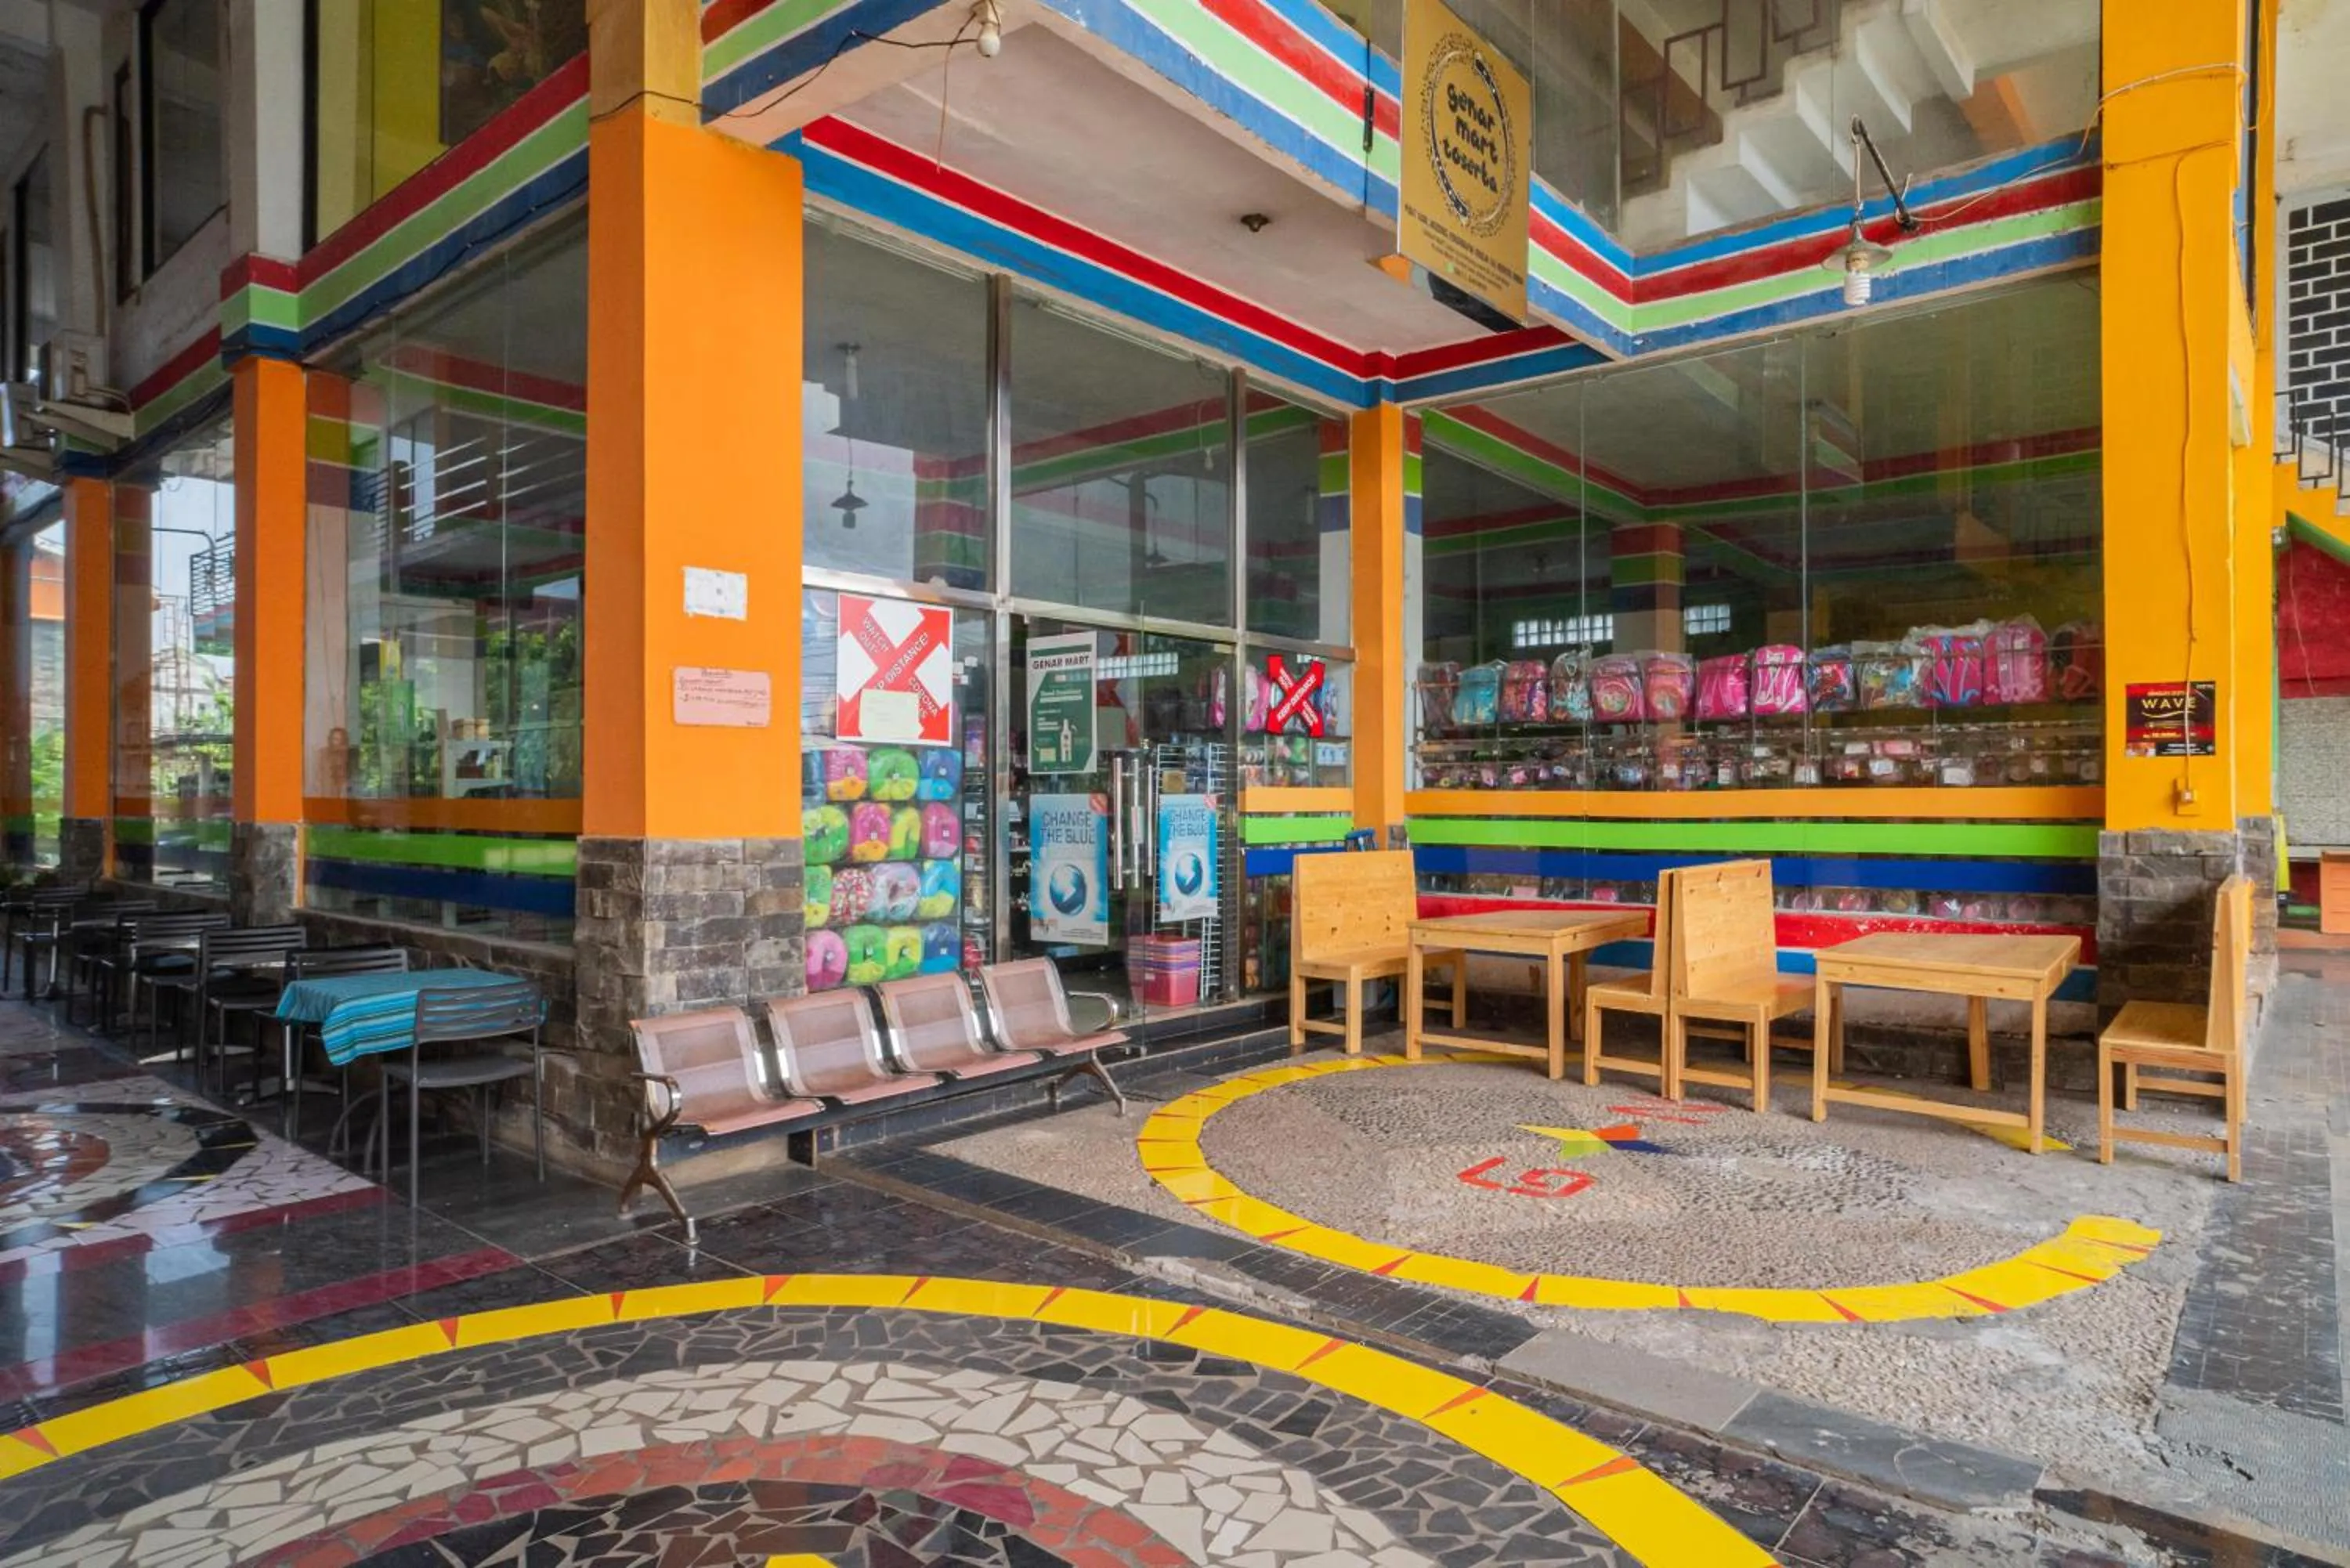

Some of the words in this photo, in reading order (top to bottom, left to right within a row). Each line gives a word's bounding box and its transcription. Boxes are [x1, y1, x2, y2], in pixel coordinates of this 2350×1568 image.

[1065, 655, 1090, 666] MART
[2141, 696, 2196, 710] WAVE
[1043, 811, 1092, 828] CHANGE
[1170, 808, 1207, 823] CHANGE
[1040, 828, 1063, 844] THE
[1066, 828, 1097, 844] BLUE
